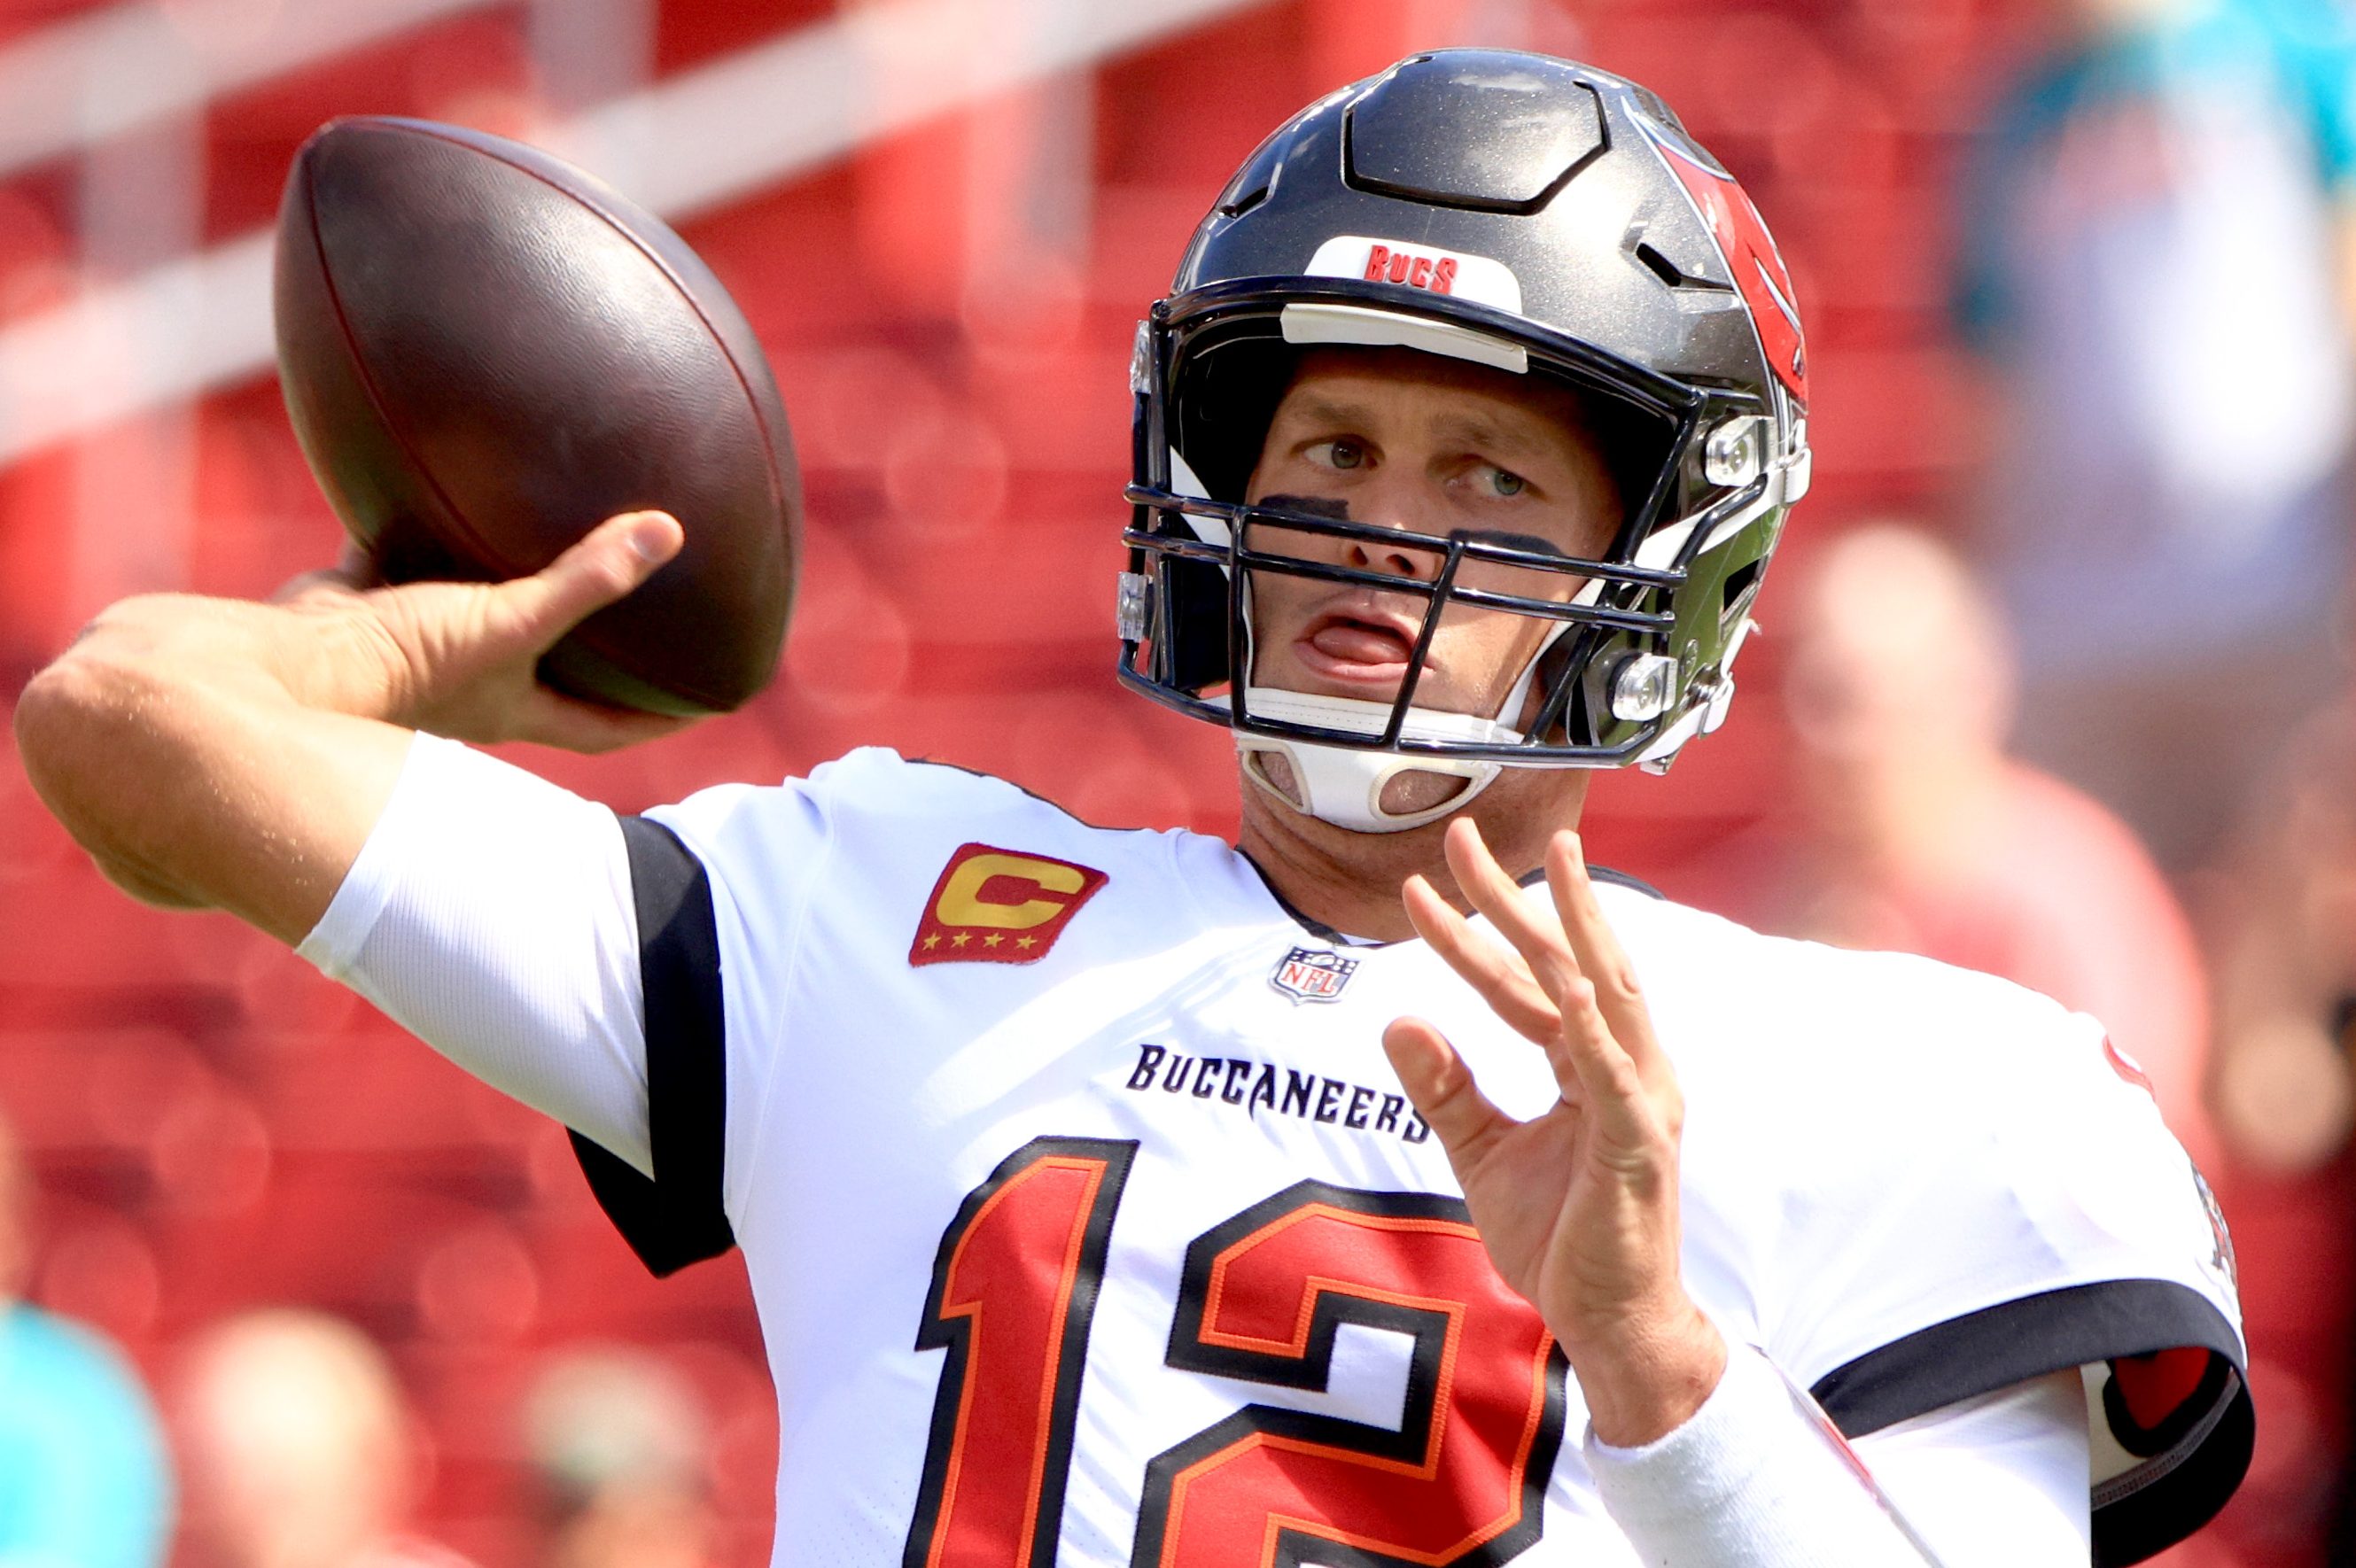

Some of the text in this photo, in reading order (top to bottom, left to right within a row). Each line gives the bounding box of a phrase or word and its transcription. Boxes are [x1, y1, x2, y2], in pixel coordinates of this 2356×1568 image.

[936, 853, 1086, 929] C
[1280, 962, 1339, 994] NFL
[903, 1136, 1569, 1568] 12
